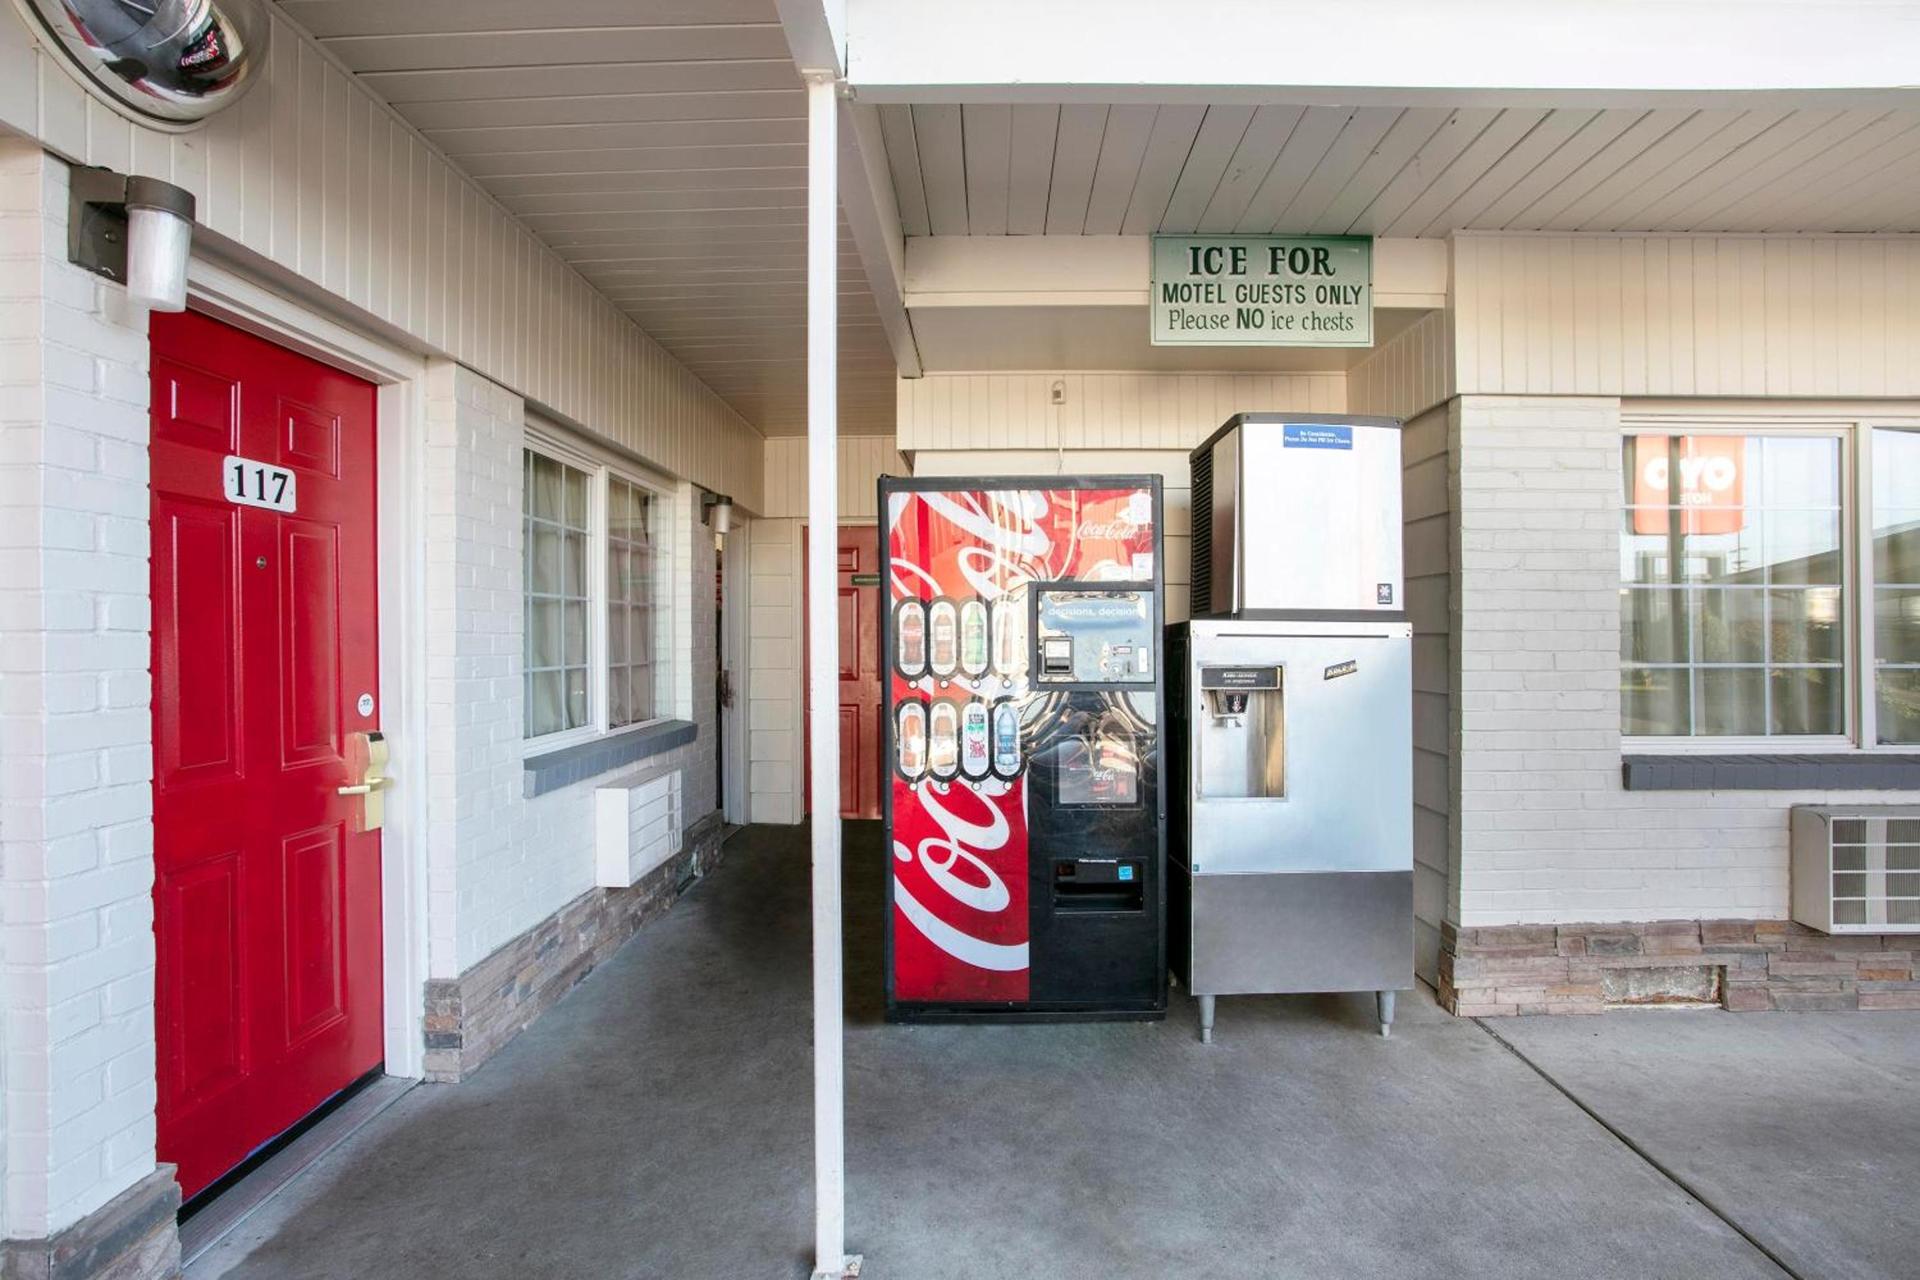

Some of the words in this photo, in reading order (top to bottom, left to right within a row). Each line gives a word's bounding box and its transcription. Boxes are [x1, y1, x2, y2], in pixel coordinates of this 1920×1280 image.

[1189, 247, 1247, 276] ICE
[1268, 247, 1336, 276] FOR
[1162, 283, 1227, 304] MOTEL
[1235, 284, 1307, 304] GUESTS
[1316, 285, 1363, 305] ONLY
[1169, 308, 1230, 330] Please
[1236, 308, 1265, 330] NO
[1271, 310, 1295, 330] ice
[1302, 311, 1355, 331] chests
[234, 464, 288, 503] 117
[1098, 607, 1140, 617] decision
